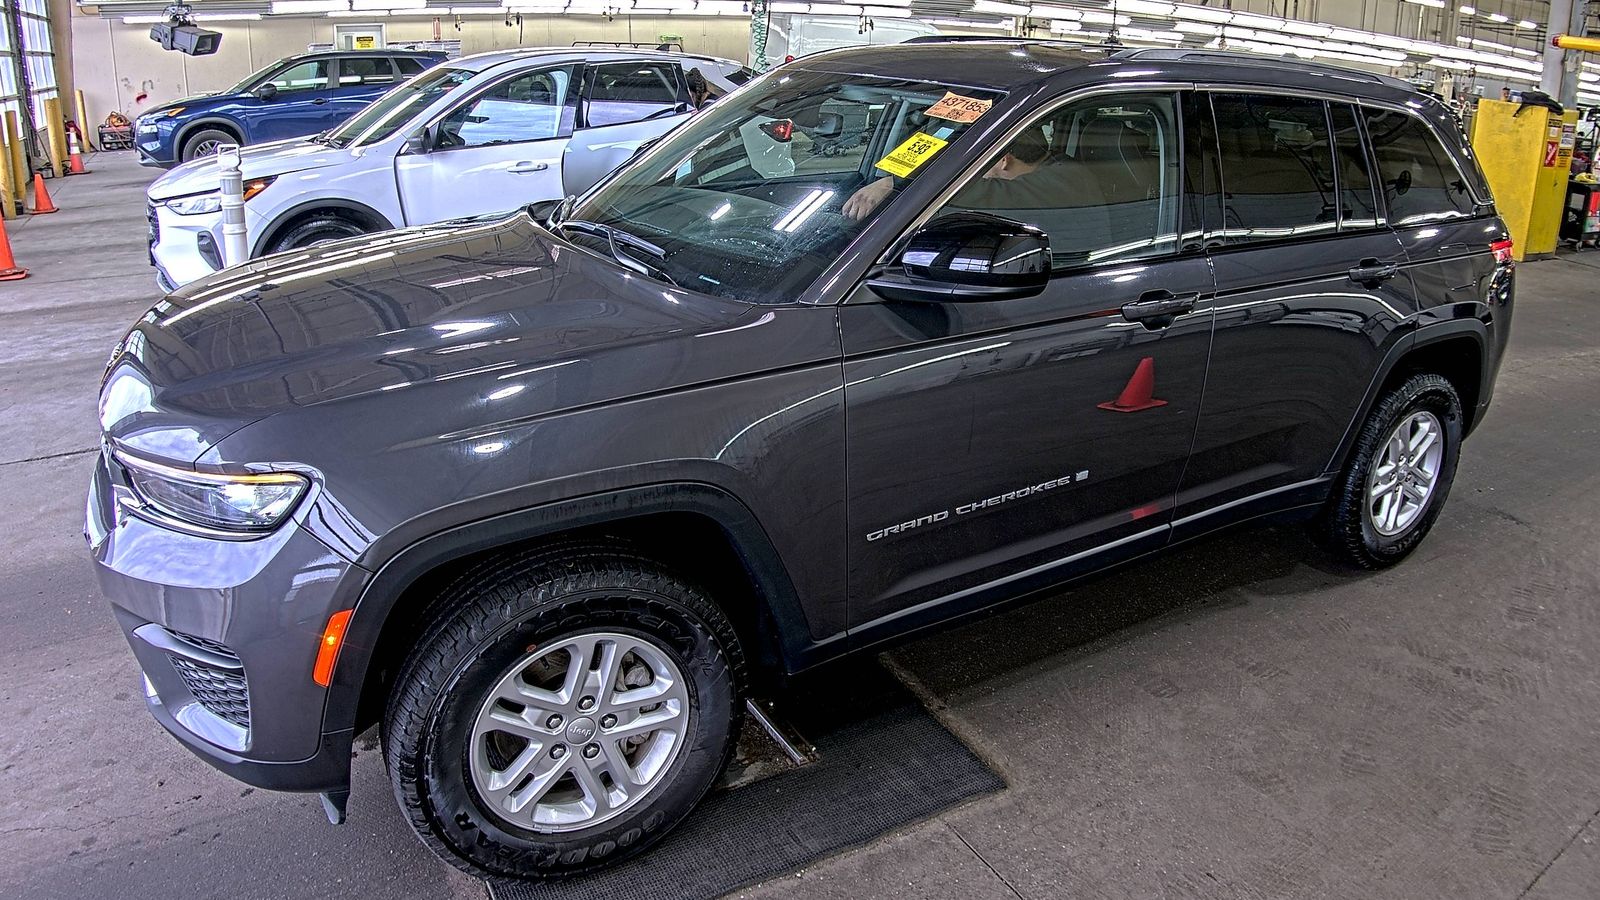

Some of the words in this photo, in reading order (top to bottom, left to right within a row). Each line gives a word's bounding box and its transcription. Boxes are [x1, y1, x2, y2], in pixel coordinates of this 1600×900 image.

[941, 96, 990, 114] 4371853
[866, 510, 949, 542] GRAND
[955, 475, 1071, 515] CHEROKEE
[572, 726, 591, 737] Jeep
